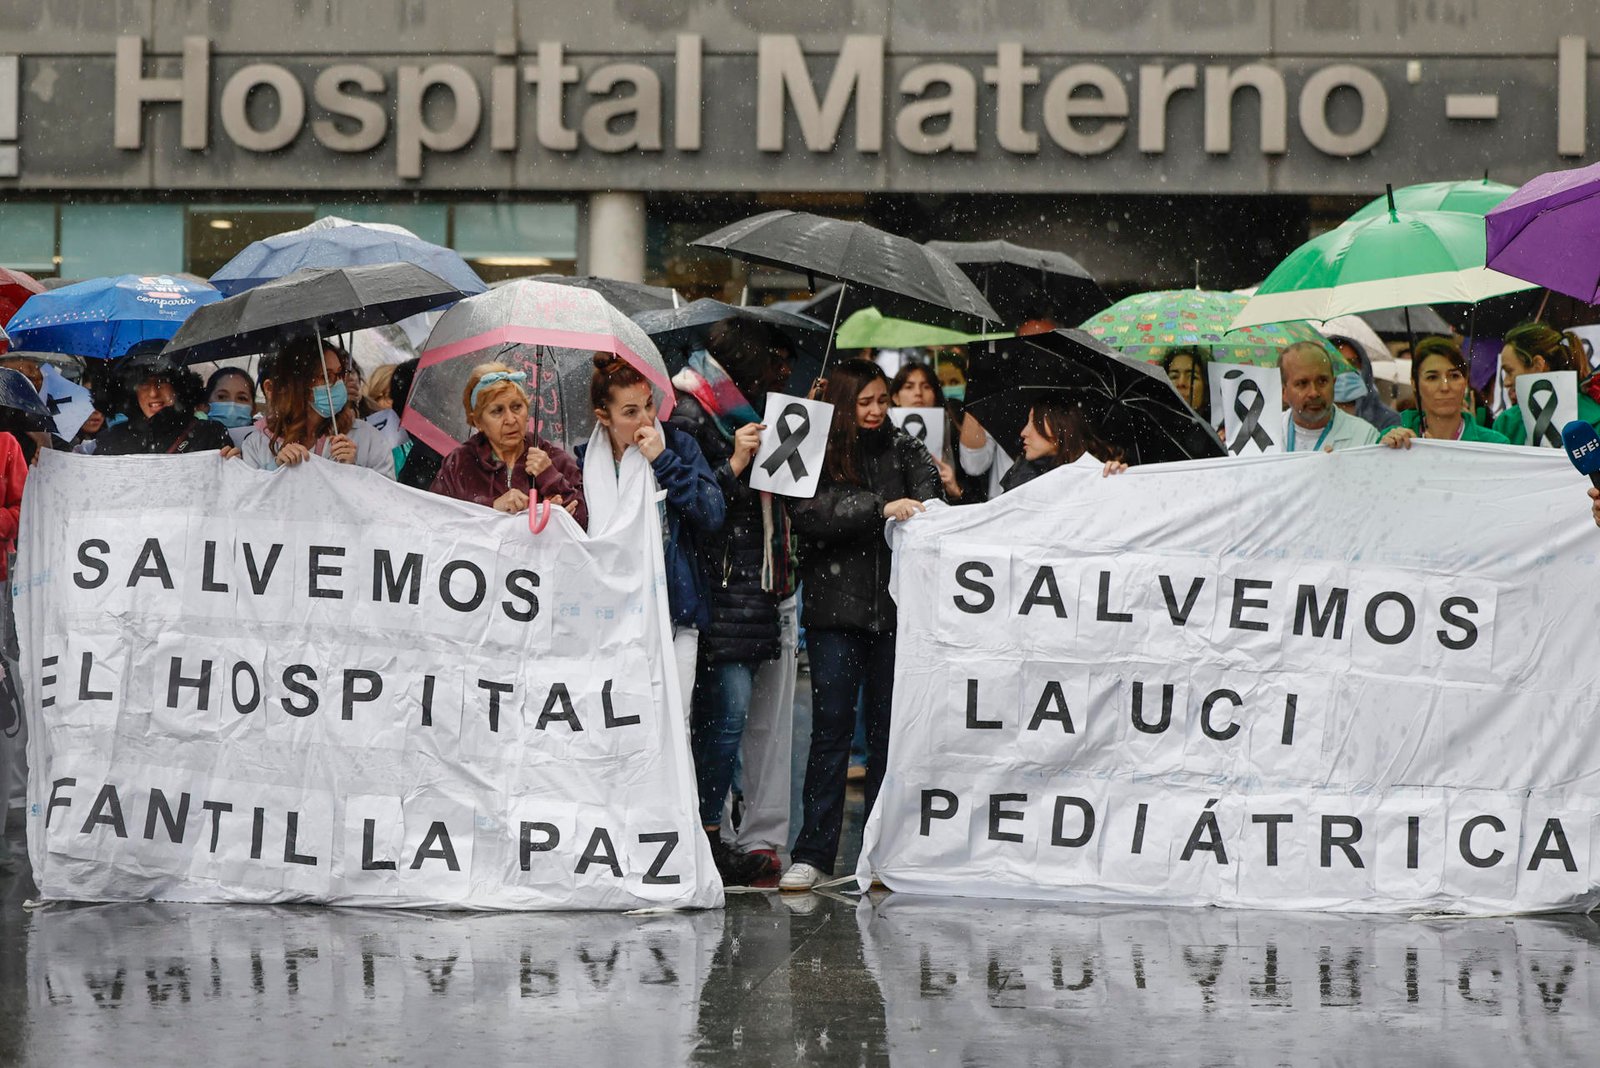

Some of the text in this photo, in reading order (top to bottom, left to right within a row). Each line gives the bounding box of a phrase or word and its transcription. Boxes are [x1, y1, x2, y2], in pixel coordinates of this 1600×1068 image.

[113, 35, 702, 180] Hospital
[757, 34, 1390, 157] Materno
[136, 296, 196, 308] compartir
[73, 537, 541, 623] SALVEMOS
[953, 561, 1479, 651] SALVEMOS
[166, 656, 641, 733] HOSPITAL
[965, 678, 1298, 746] LA UCI
[45, 777, 681, 885] FANTIL LA PAZ
[919, 788, 1578, 873] PEDIÁTRICA
